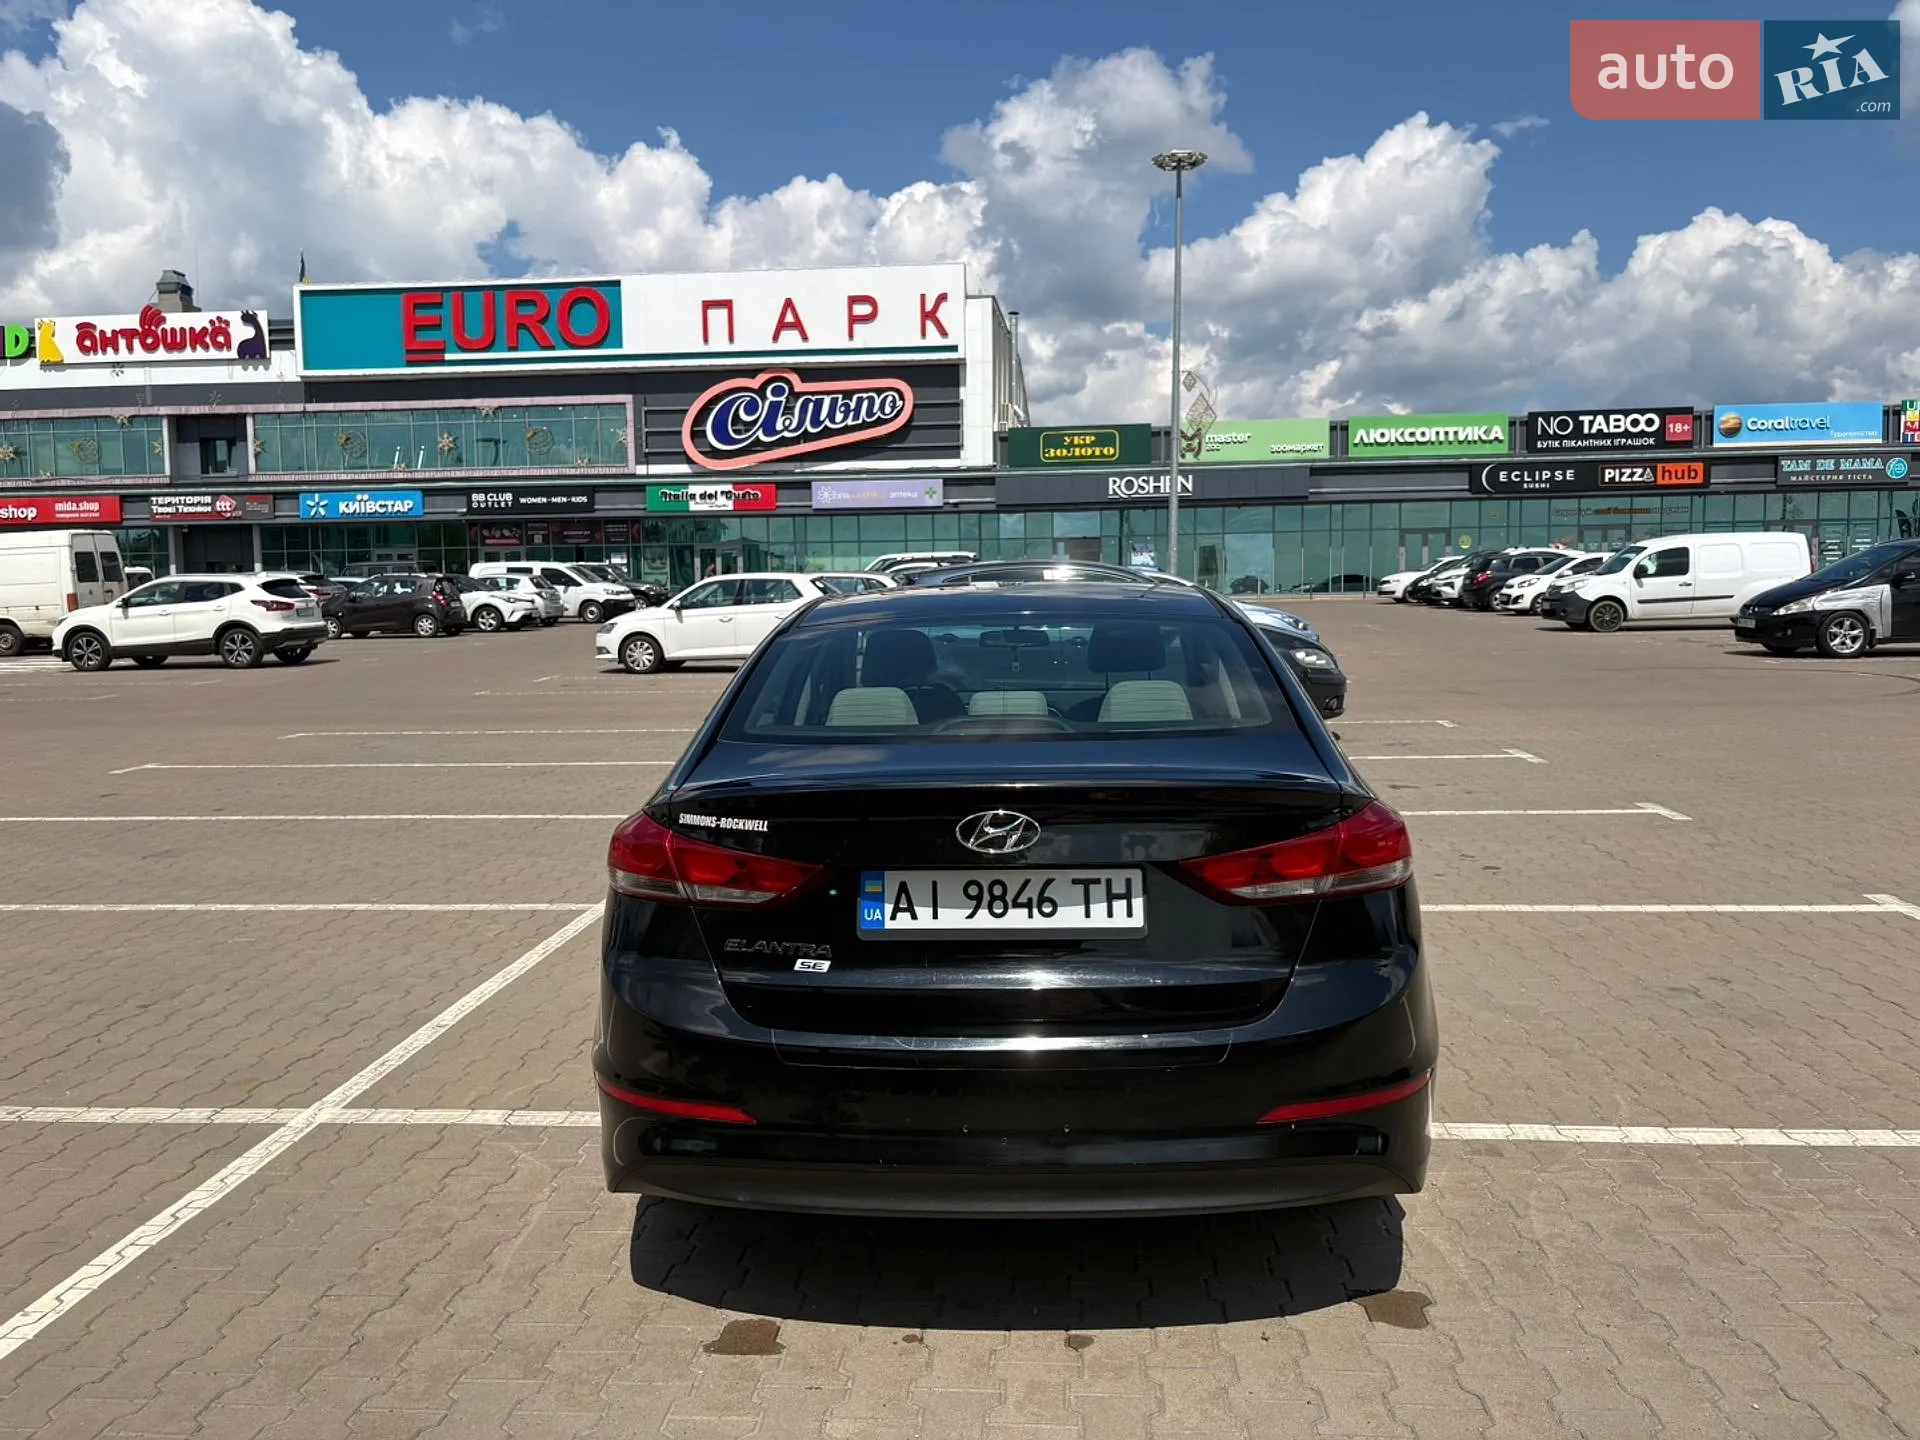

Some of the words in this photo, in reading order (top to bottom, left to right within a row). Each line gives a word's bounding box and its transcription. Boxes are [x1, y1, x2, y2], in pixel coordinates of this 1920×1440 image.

[402, 286, 611, 351] EURO
[706, 382, 903, 450] Сільпо
[1537, 415, 1574, 436] NO
[1579, 413, 1660, 434] TABOO
[1667, 422, 1691, 434] 18+
[1063, 435, 1096, 446] УКР
[1205, 432, 1252, 443] master
[1354, 425, 1504, 445] ЛЮКСОПТИКА
[1537, 440, 1561, 448] БУТІК
[1562, 438, 1612, 448] ПІКАНТНИХ
[1613, 437, 1656, 447] ІГРАШОК
[1044, 446, 1115, 458] ЗОЛОТО
[1499, 469, 1575, 482] ECLIPSE
[1604, 468, 1655, 482] PIZZA
[1661, 465, 1698, 481] hub
[1108, 475, 1193, 498] ROSHEN
[150, 495, 212, 505] ТЕРИТОРІЯ
[338, 494, 414, 514] КИЇВСТАР
[471, 493, 486, 501] BB
[487, 492, 513, 501] CLUB
[0, 505, 38, 521] shop
[678, 812, 769, 832] SIMMONS-ROCKWELL
[889, 880, 940, 921] AI
[962, 877, 1059, 919] 9846
[1071, 877, 1133, 919] TH
[864, 908, 882, 920] UA
[724, 938, 833, 958] ELANTRA
